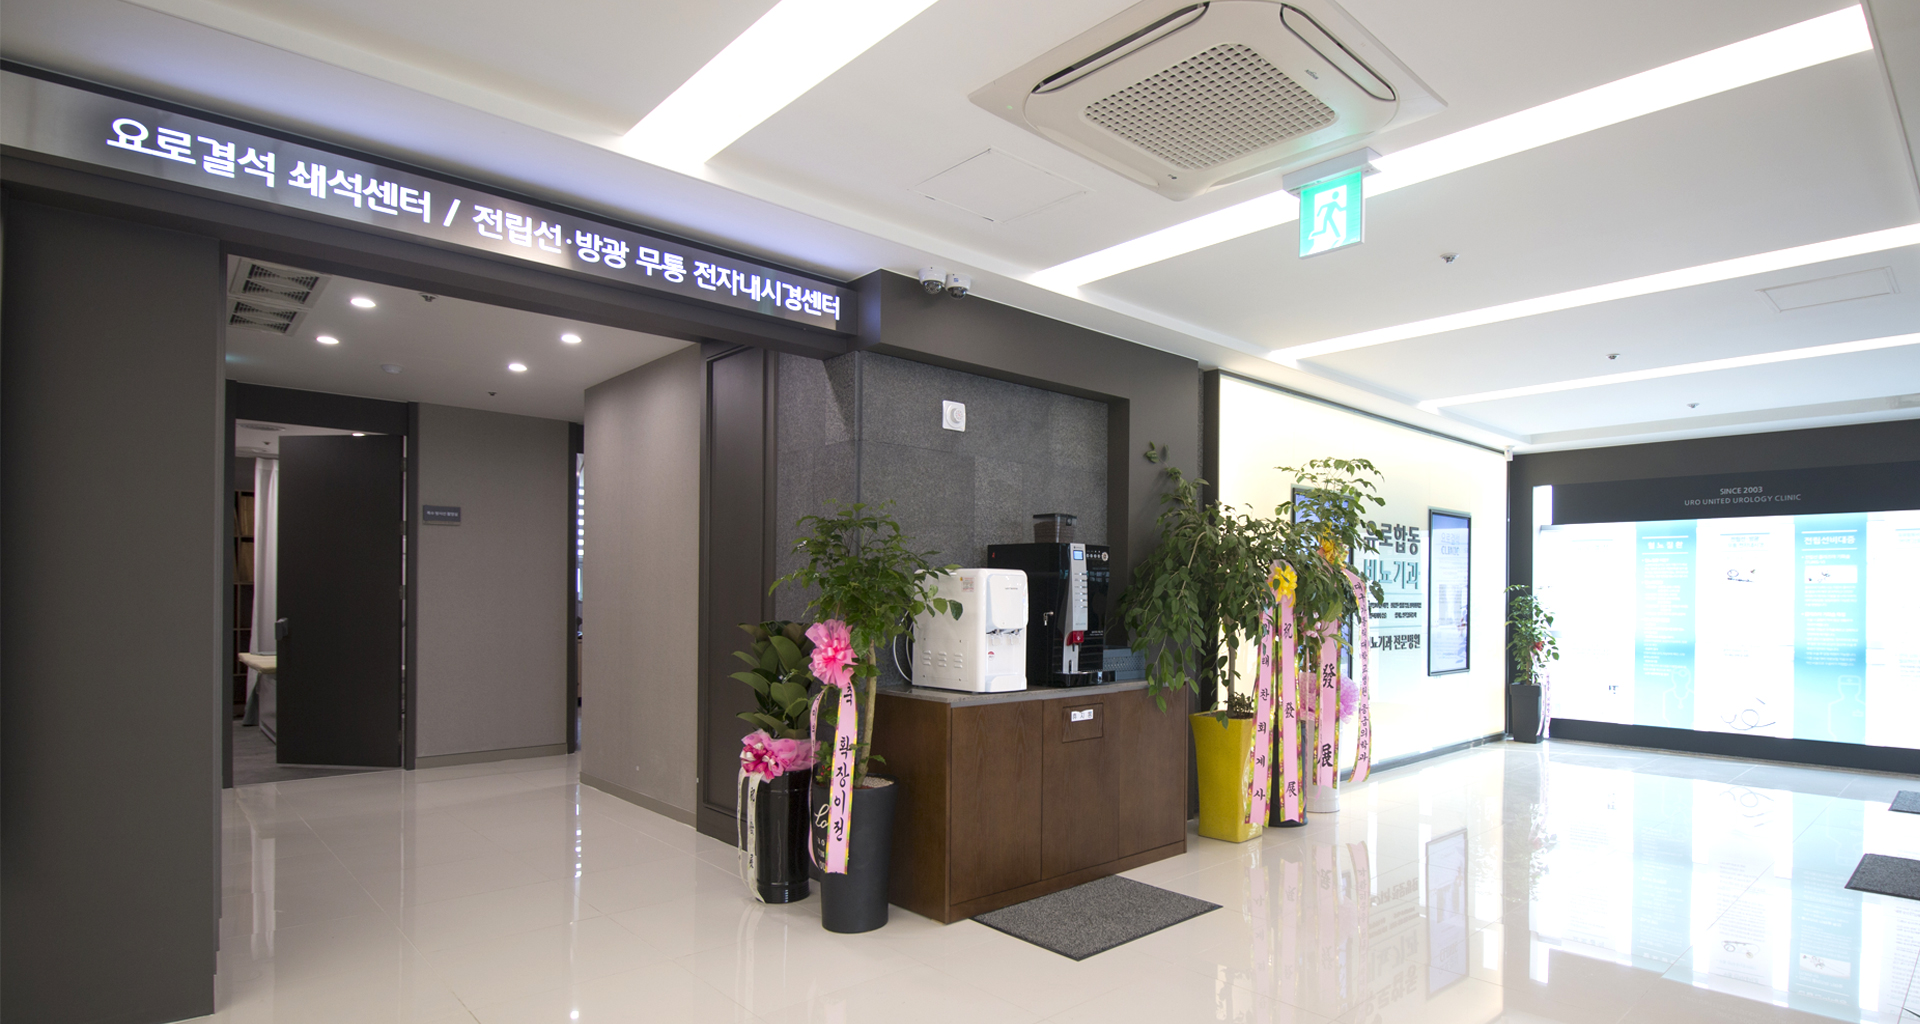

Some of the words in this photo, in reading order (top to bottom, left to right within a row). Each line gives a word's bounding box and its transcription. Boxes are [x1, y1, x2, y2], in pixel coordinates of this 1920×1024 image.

[106, 117, 276, 188] 요로결석
[288, 159, 431, 224] 쇄석센터
[443, 198, 461, 227] /
[635, 246, 687, 284] 무통
[693, 259, 841, 322] 전자내시경센터
[1702, 497, 1731, 505] UNITED
[1732, 495, 1773, 504] UROLOGY
[1774, 493, 1801, 502] CLINIC
[1720, 487, 1742, 495] SINCE
[1743, 486, 1763, 494] 2003
[1363, 520, 1421, 555] 유로합동
[1804, 534, 1856, 545] 전립선비대증
[1364, 558, 1421, 589] 비뇨기과
[1393, 633, 1421, 650] 전문병원
[833, 735, 851, 842] 확장이전
